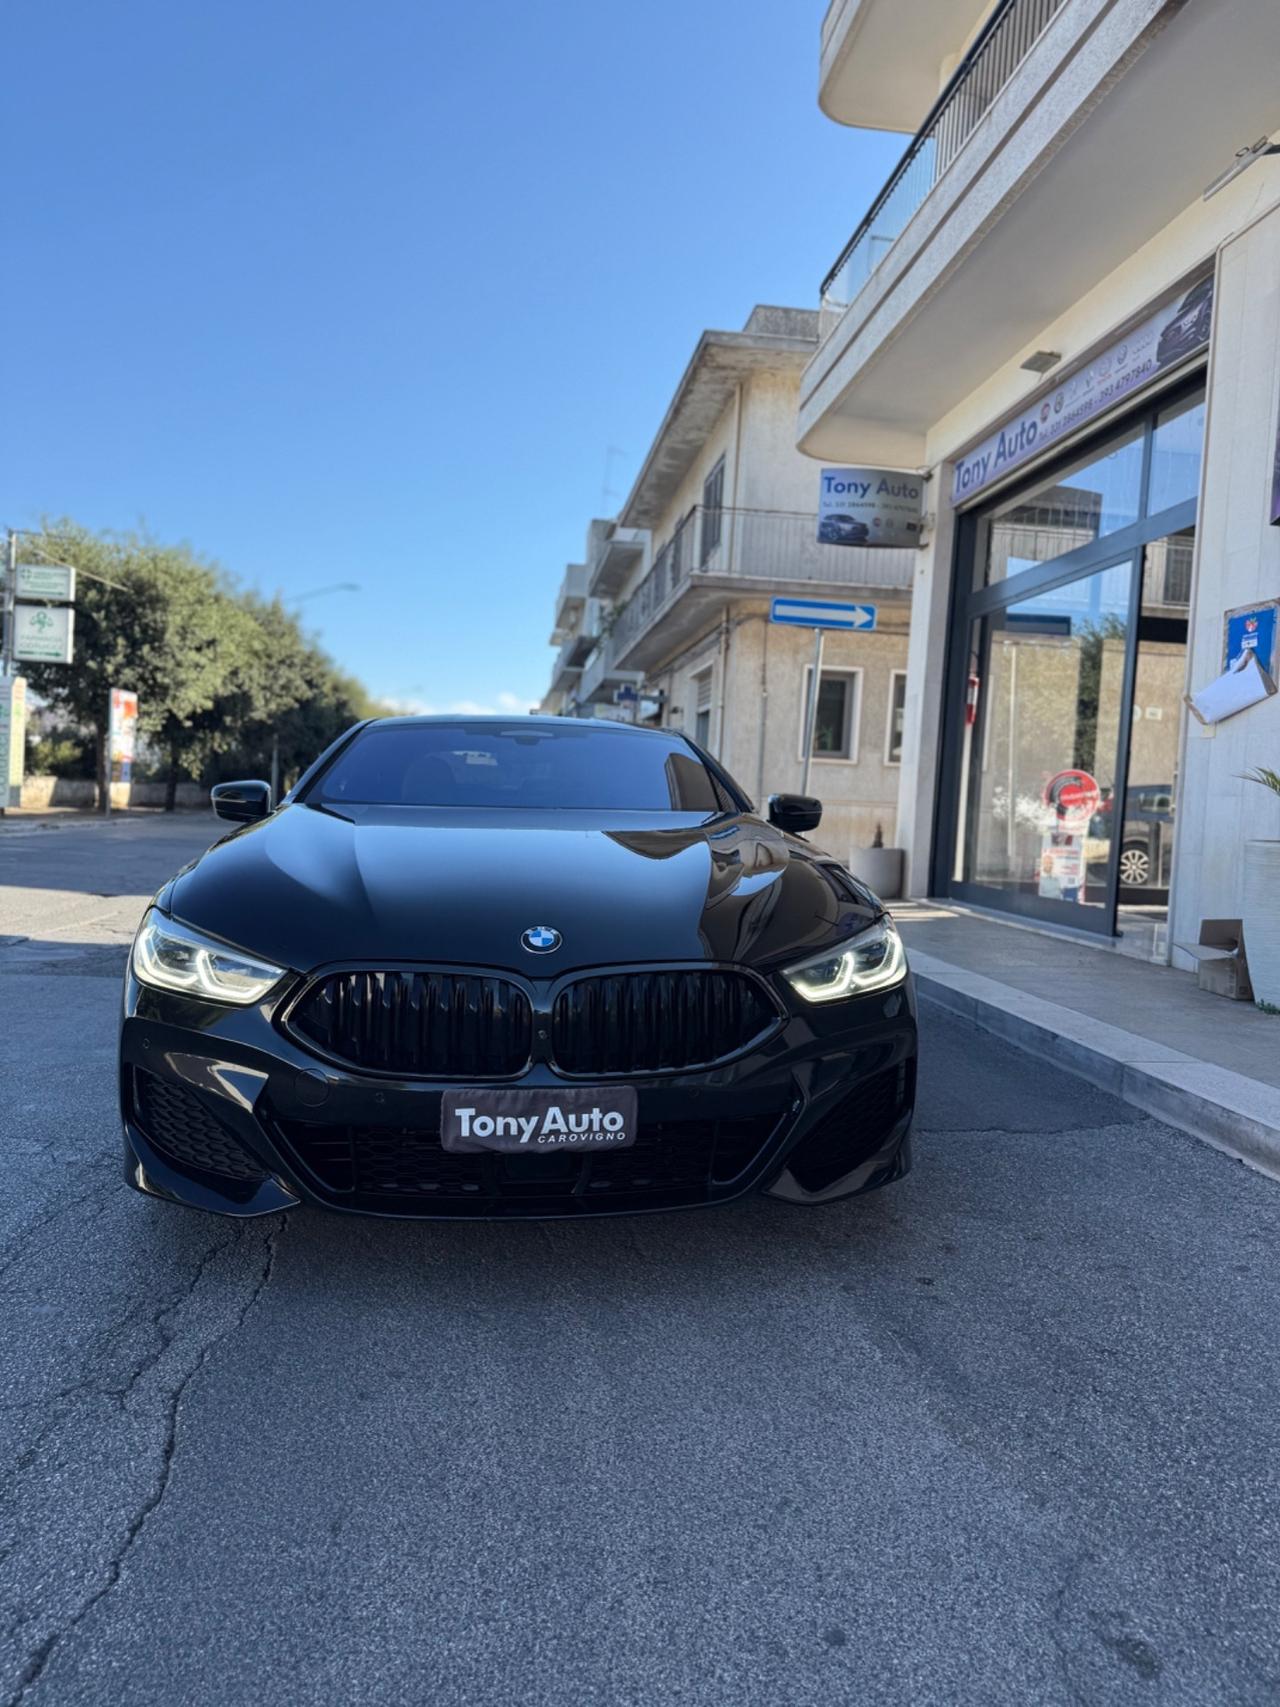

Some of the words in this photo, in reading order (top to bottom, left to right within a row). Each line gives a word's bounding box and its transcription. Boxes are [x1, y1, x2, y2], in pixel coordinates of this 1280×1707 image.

[955, 452, 991, 493] Tony
[994, 420, 1038, 467] Auto
[823, 476, 871, 499] Tony
[876, 477, 919, 499] Auto
[537, 1132, 626, 1144] CAROVIGNO
